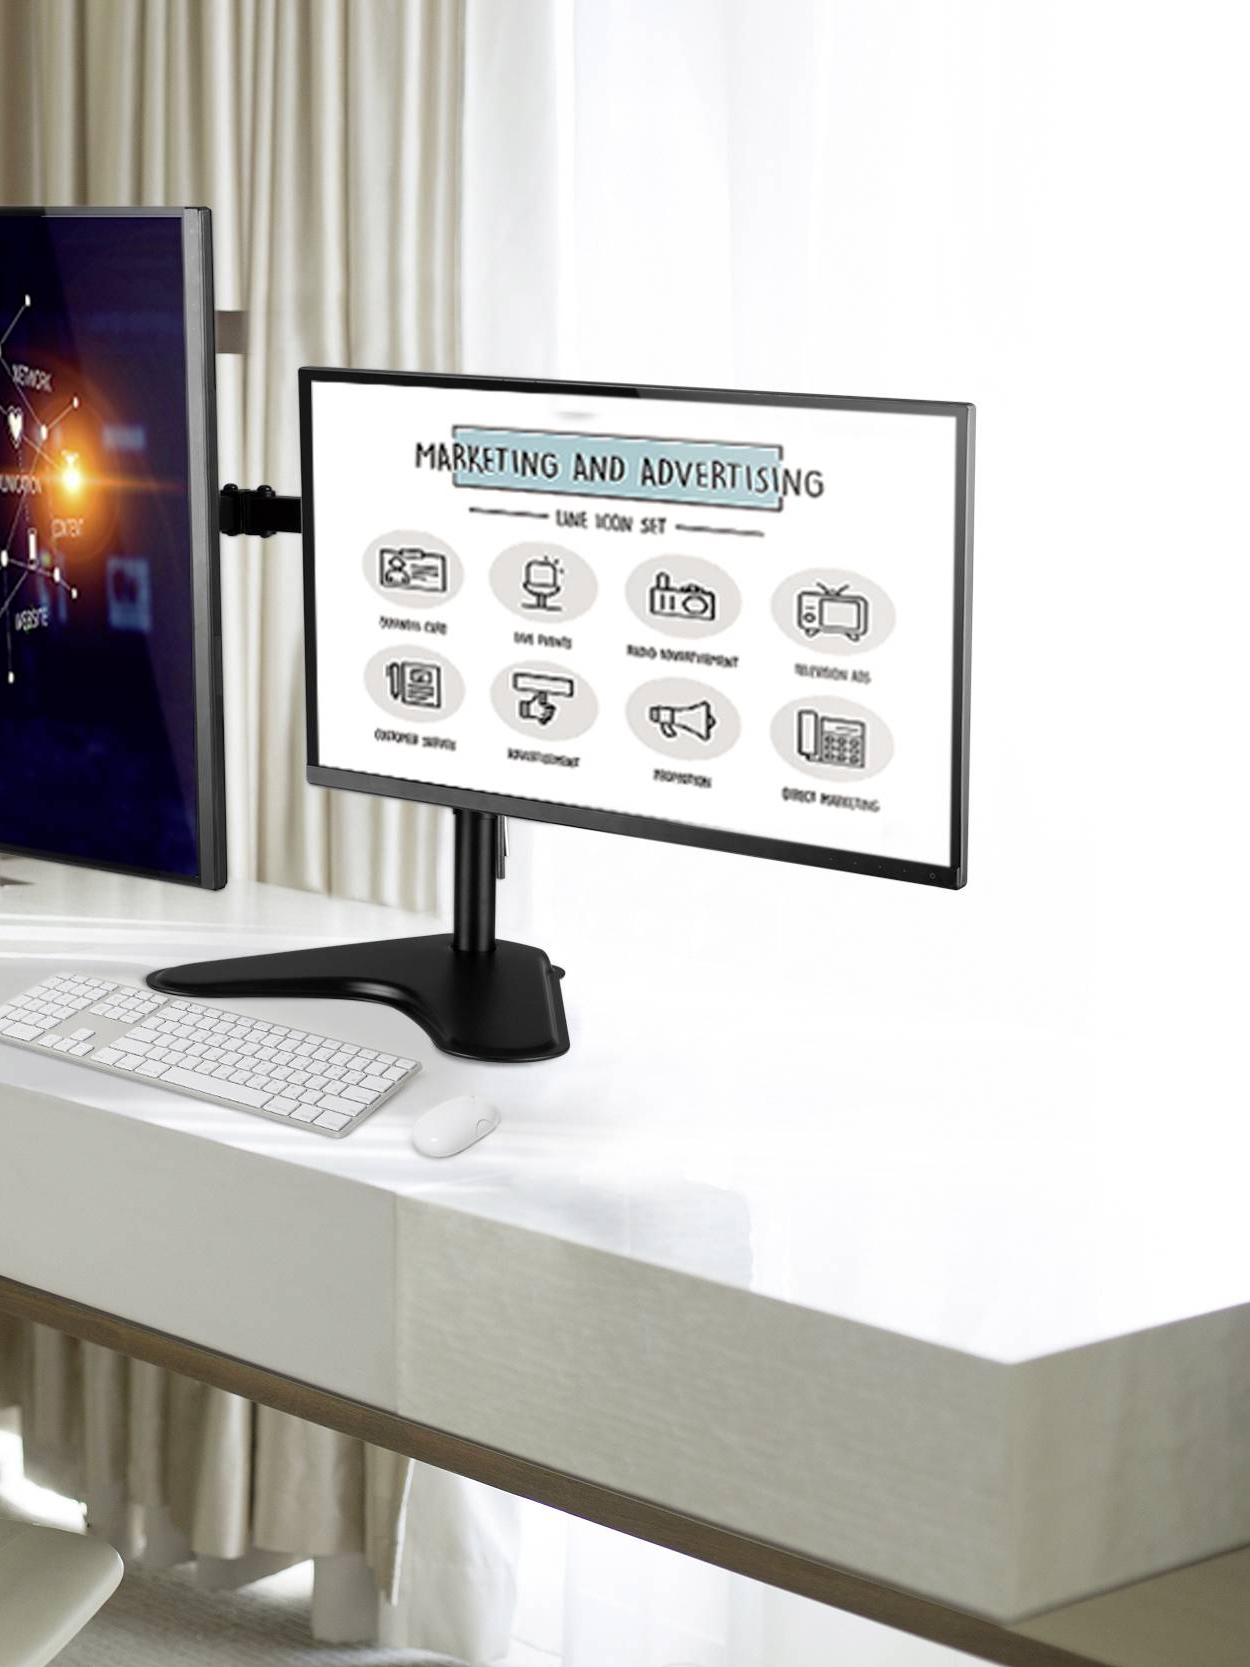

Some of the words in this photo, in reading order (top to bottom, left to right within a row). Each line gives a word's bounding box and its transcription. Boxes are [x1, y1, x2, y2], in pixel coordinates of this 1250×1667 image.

[415, 441, 559, 479] MARKETING
[573, 453, 626, 482] AND
[641, 458, 825, 499] ADVERTISING
[555, 509, 588, 529] LINE
[594, 512, 634, 533] ICON
[640, 517, 667, 535] SET
[851, 669, 871, 685] ADS
